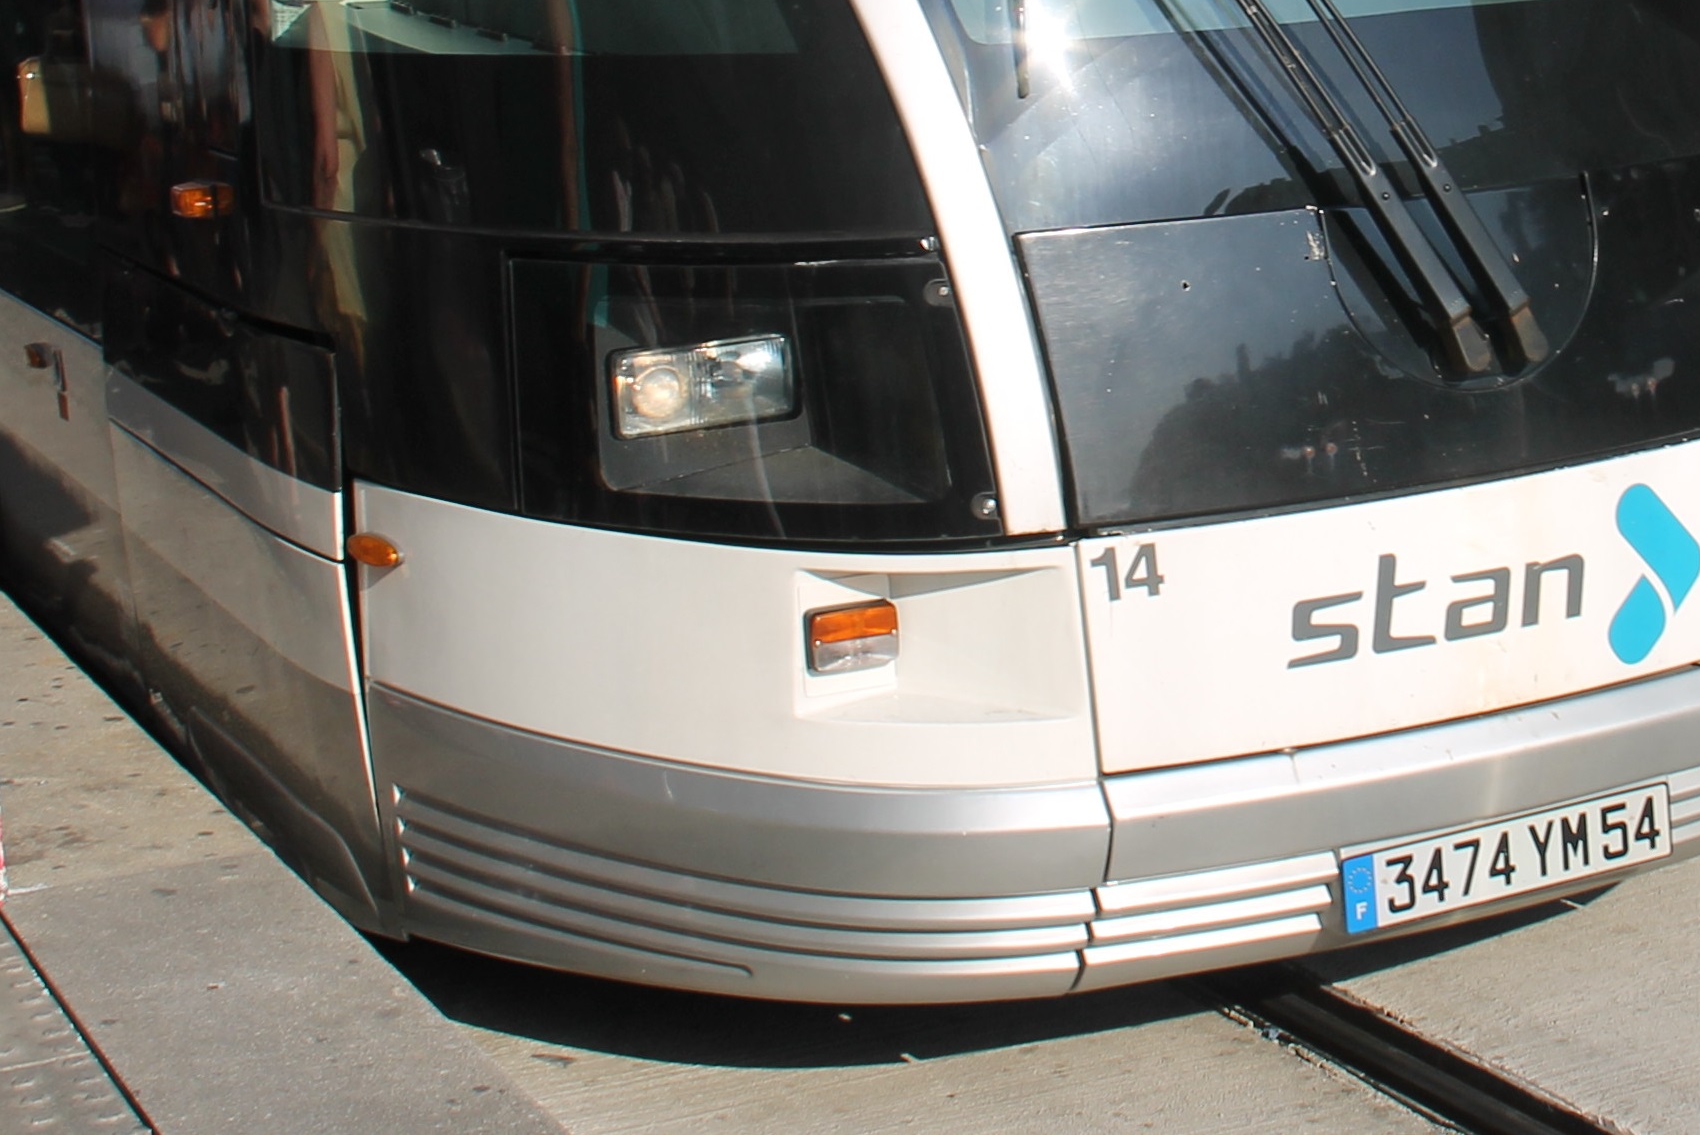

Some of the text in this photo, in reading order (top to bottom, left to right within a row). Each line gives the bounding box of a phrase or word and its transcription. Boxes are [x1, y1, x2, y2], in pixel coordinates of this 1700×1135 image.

[1090, 543, 1165, 602] 14
[1287, 553, 1586, 669] stan
[1384, 795, 1661, 914] 3474 YM 54
